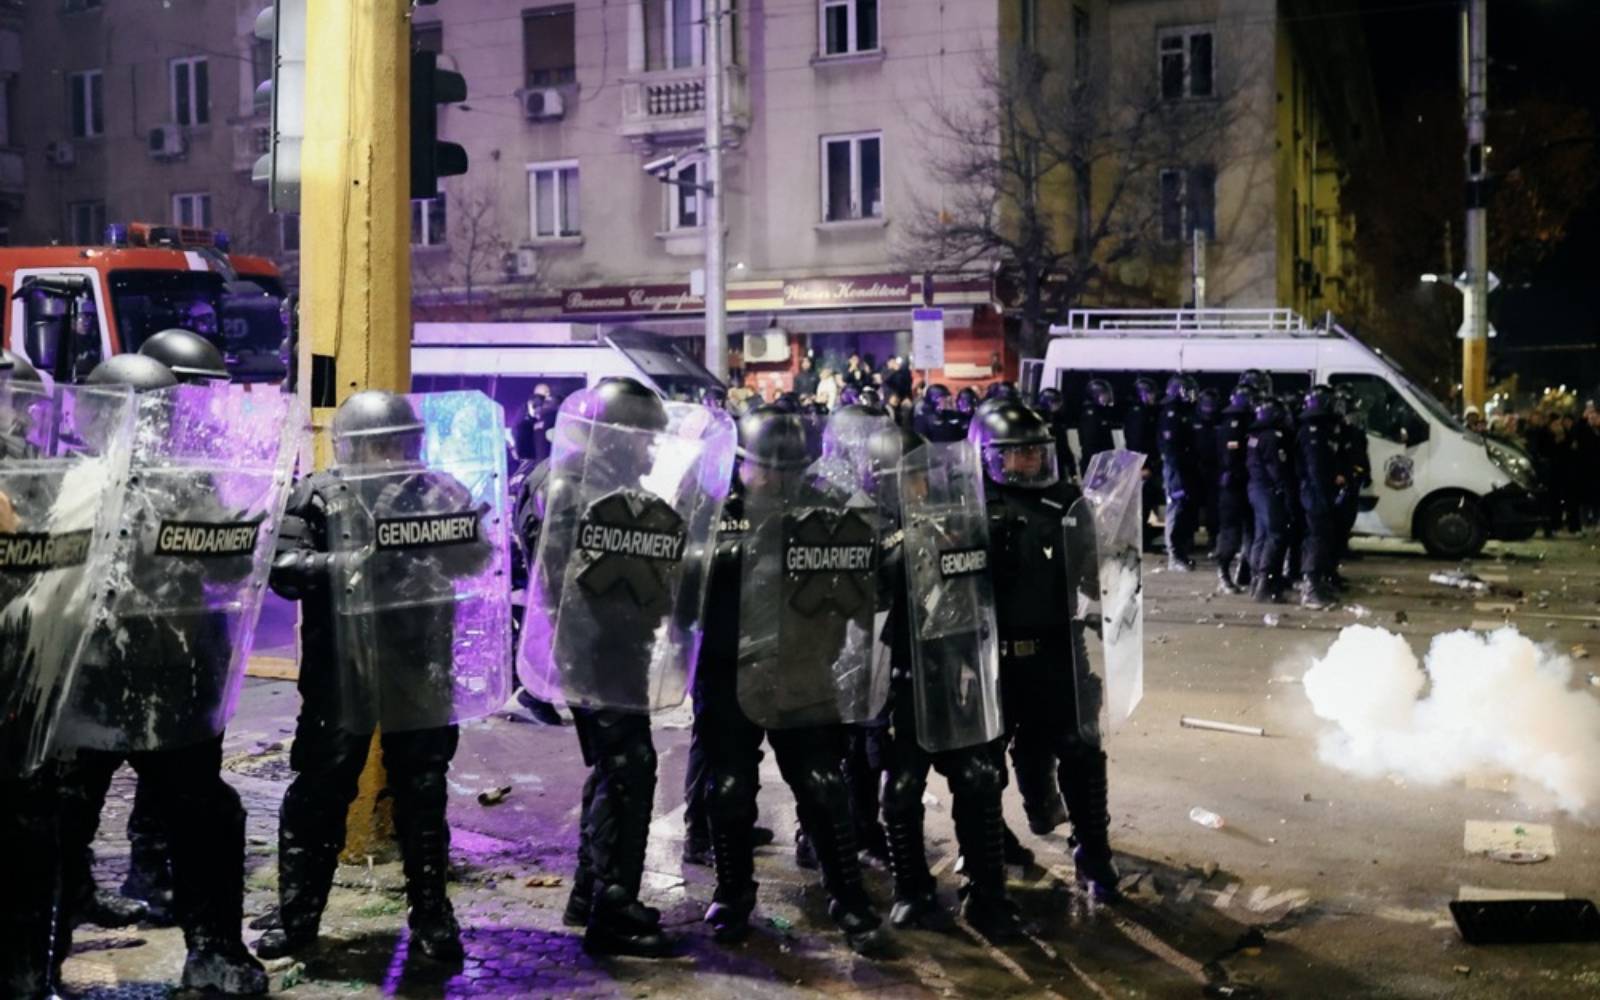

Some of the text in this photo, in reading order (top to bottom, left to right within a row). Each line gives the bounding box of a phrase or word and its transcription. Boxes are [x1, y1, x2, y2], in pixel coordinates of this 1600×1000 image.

[160, 525, 257, 552] GENDARMERY
[378, 516, 477, 546] GENDARMERY
[581, 524, 683, 559] GENDARMERY
[786, 545, 873, 570] GENDARMERY
